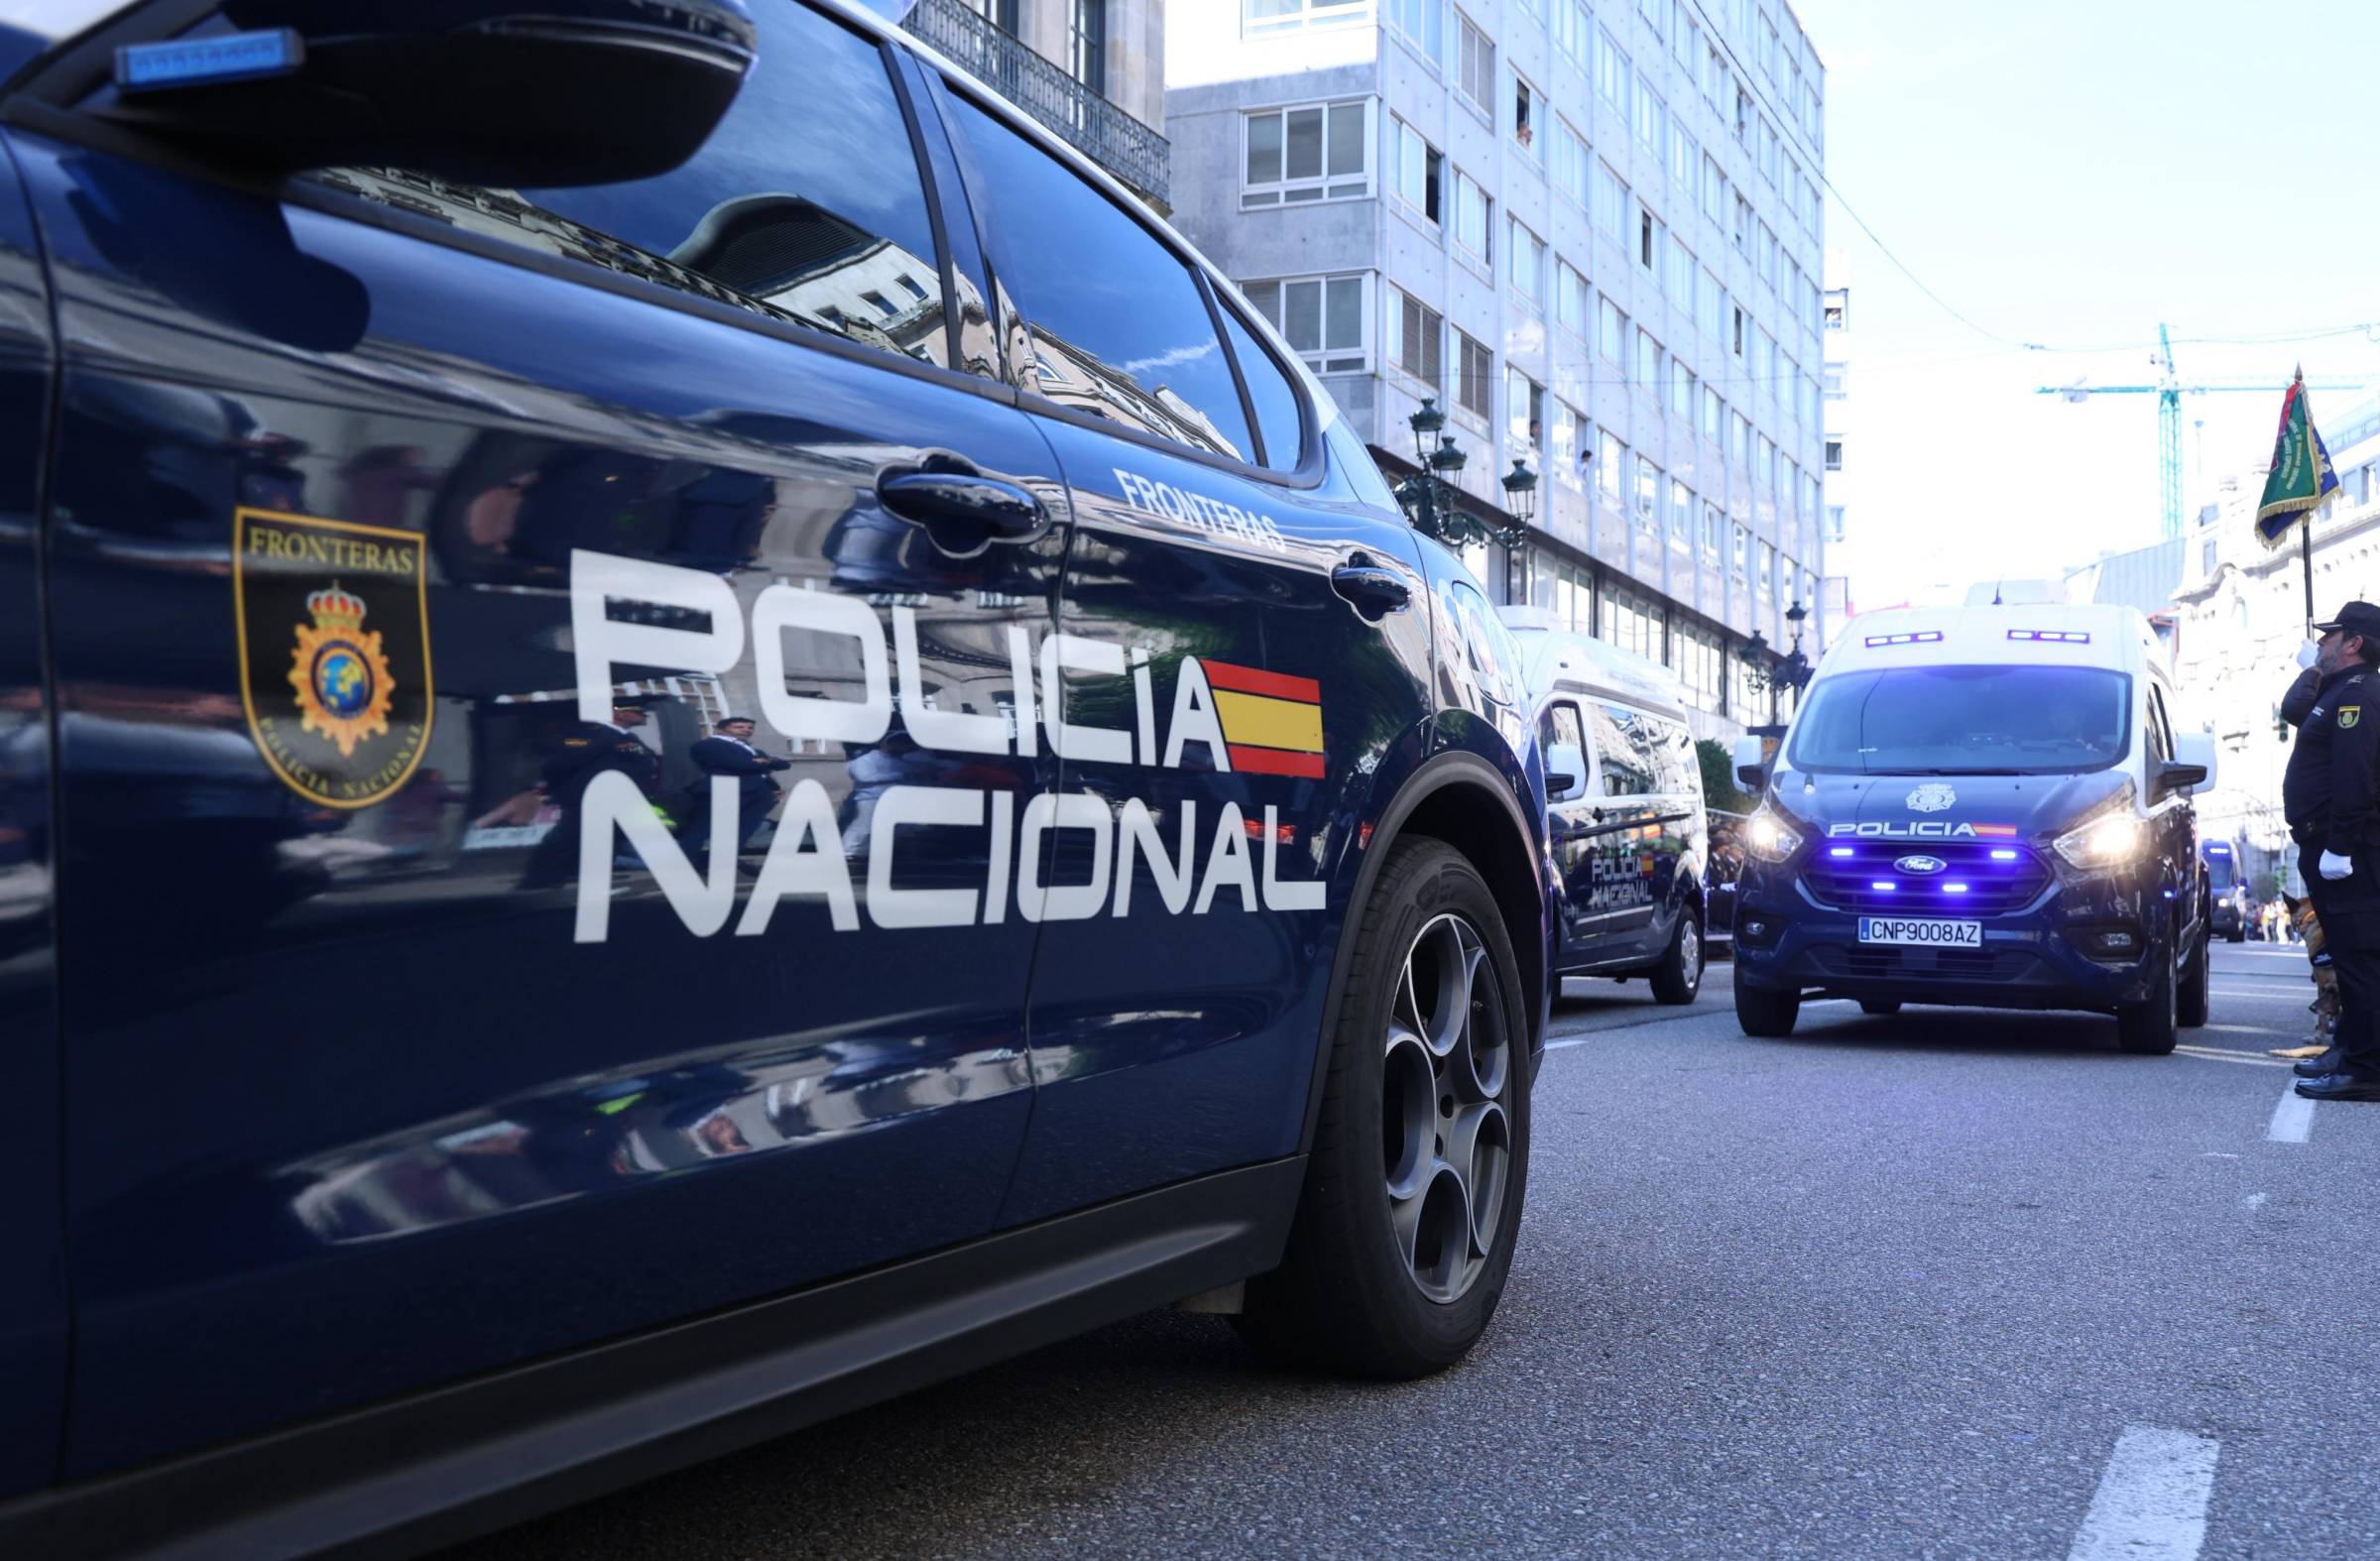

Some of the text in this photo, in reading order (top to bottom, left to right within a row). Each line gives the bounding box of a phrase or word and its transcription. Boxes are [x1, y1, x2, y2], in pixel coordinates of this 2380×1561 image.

[1112, 468, 1286, 553] FRONTERAS
[249, 527, 414, 574] FRONTERAS
[570, 548, 1231, 773] POLICIA
[1829, 822, 1976, 838] POLICIA
[574, 770, 1327, 943] NACIONAL
[1592, 856, 1643, 882] POLICIA
[1871, 920, 1977, 943] CNP9008AZ
